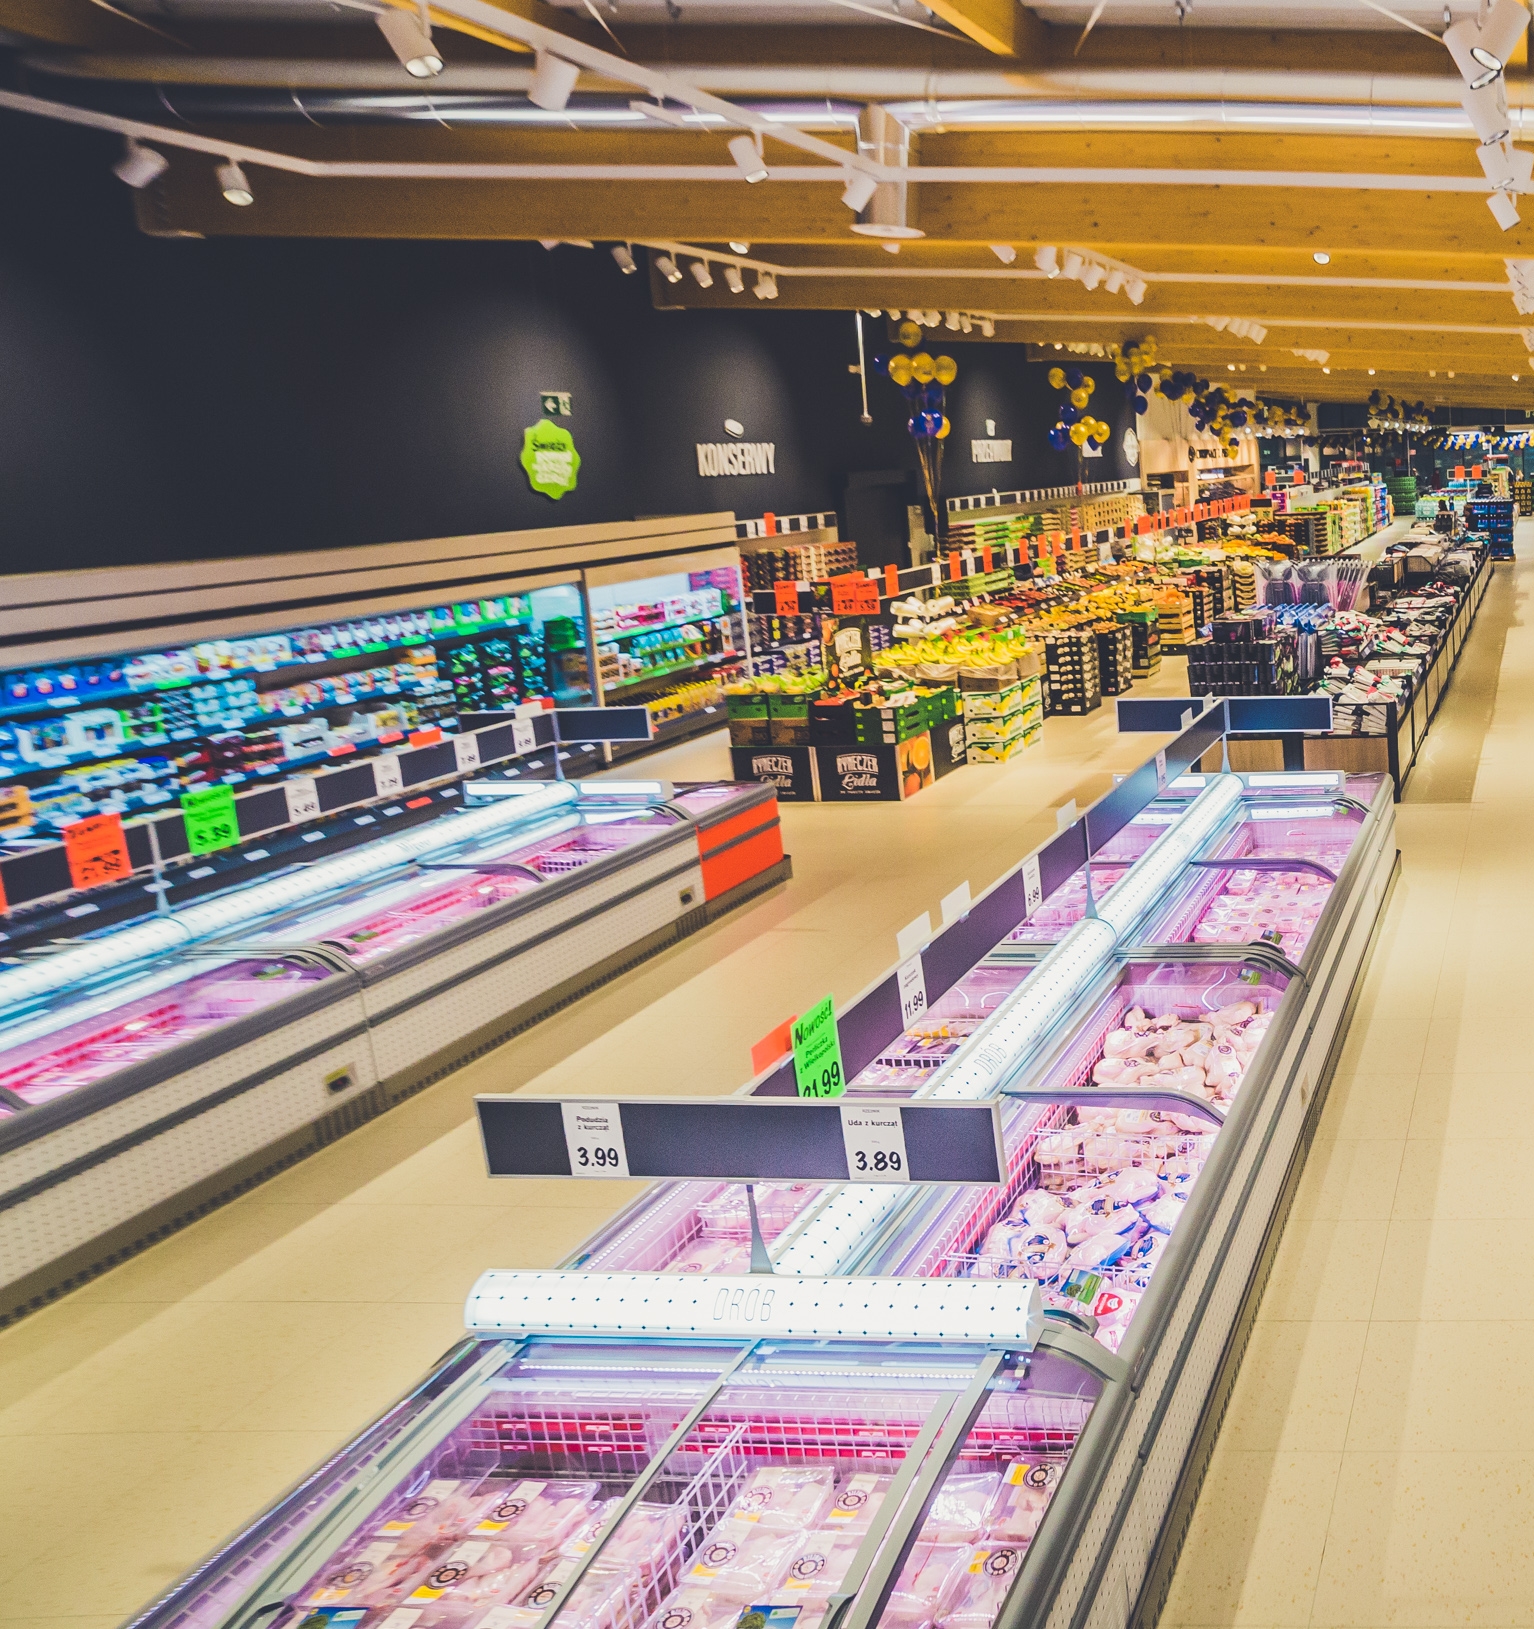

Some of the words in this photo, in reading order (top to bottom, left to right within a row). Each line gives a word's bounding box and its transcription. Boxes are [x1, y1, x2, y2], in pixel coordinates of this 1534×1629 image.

[696, 442, 776, 477] KONSERWY
[836, 755, 879, 774] RYNECZEK
[842, 774, 877, 790] Lidla
[904, 990, 924, 1020] 11.99
[795, 1000, 832, 1050] Nowość!
[576, 1115, 609, 1124] Podudzia
[871, 1119, 898, 1128] kurcząt
[577, 1146, 619, 1167] 3.99
[855, 1150, 901, 1171] 3.89
[713, 1283, 775, 1321] DRÓB
